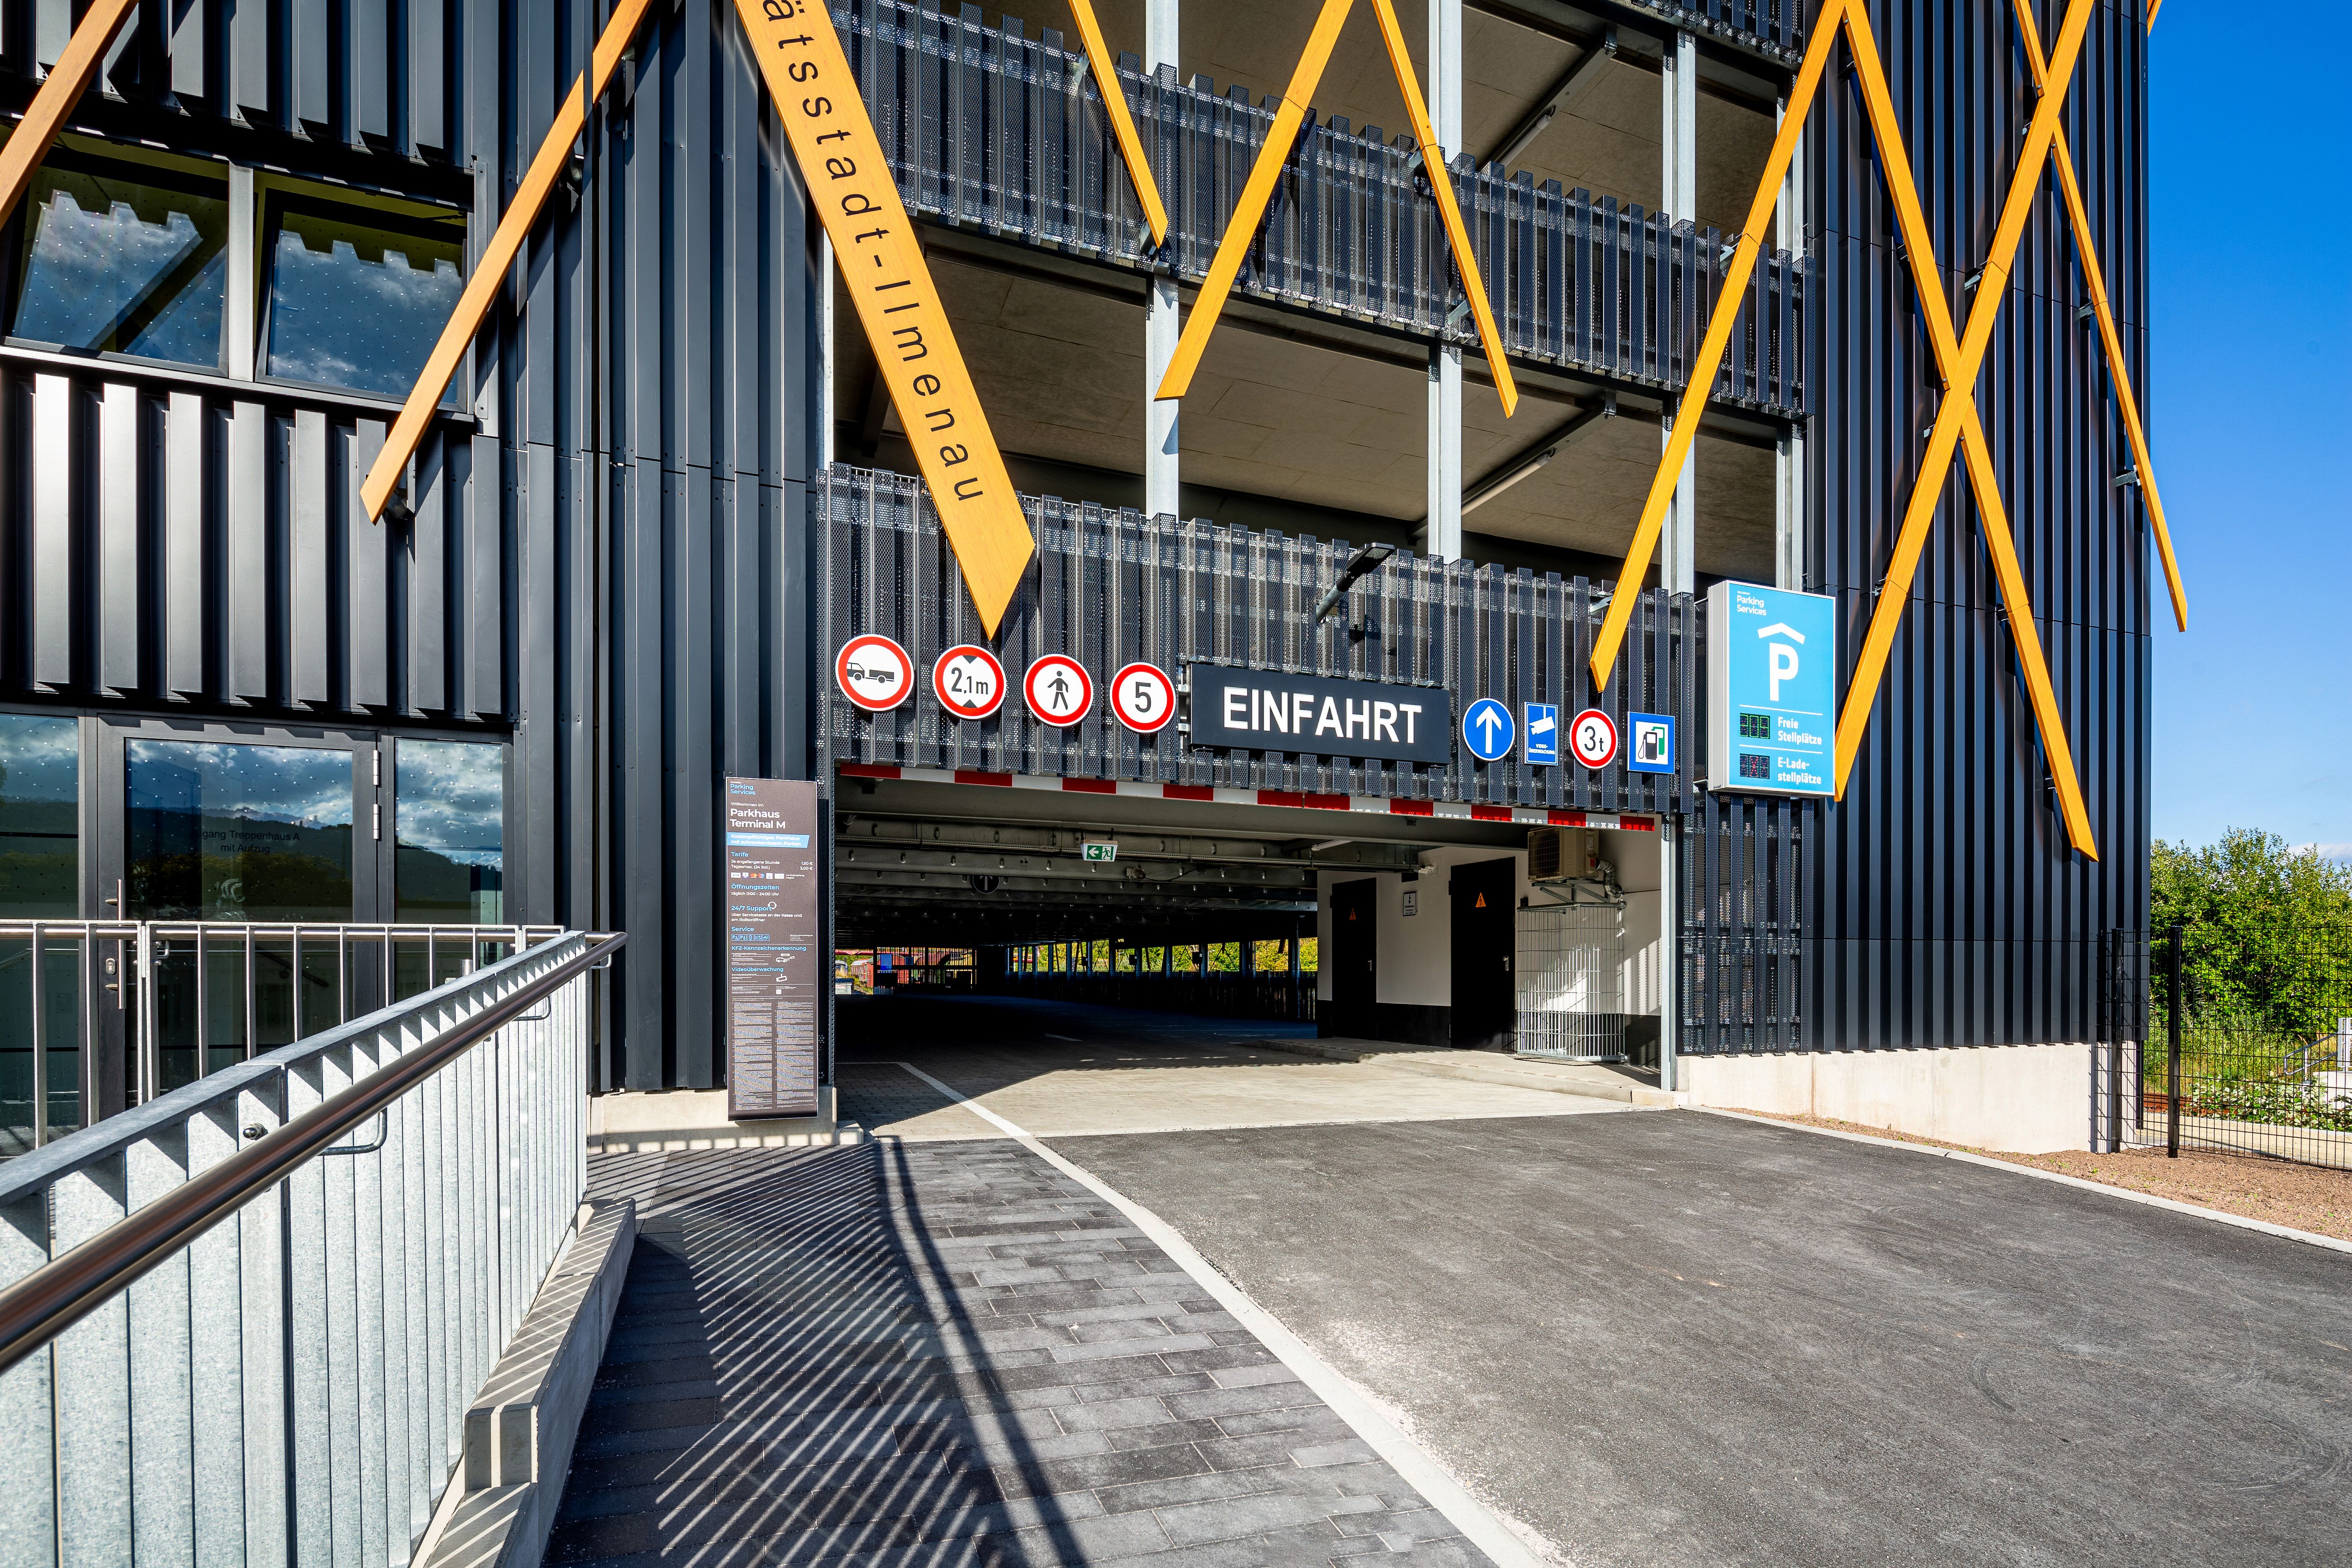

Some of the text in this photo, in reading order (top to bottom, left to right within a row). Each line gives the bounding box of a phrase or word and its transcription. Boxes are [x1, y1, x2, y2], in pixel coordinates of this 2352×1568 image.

[1737, 595, 1764, 608] Parking
[1737, 604, 1767, 616] Services
[1769, 642, 1799, 701] P
[1135, 682, 1151, 712] 5
[1224, 686, 1422, 744] EINFAHRT
[1778, 716, 1799, 729] Freie
[1778, 730, 1822, 745] Stellplätze
[1778, 757, 1810, 770] E-Lade-
[1778, 772, 1821, 785] stellplätze
[730, 808, 780, 818] Parkhaus
[730, 819, 773, 829] Terminal
[229, 830, 291, 841] Treppenhaus
[293, 833, 300, 841] A
[237, 844, 270, 855] Aufzug
